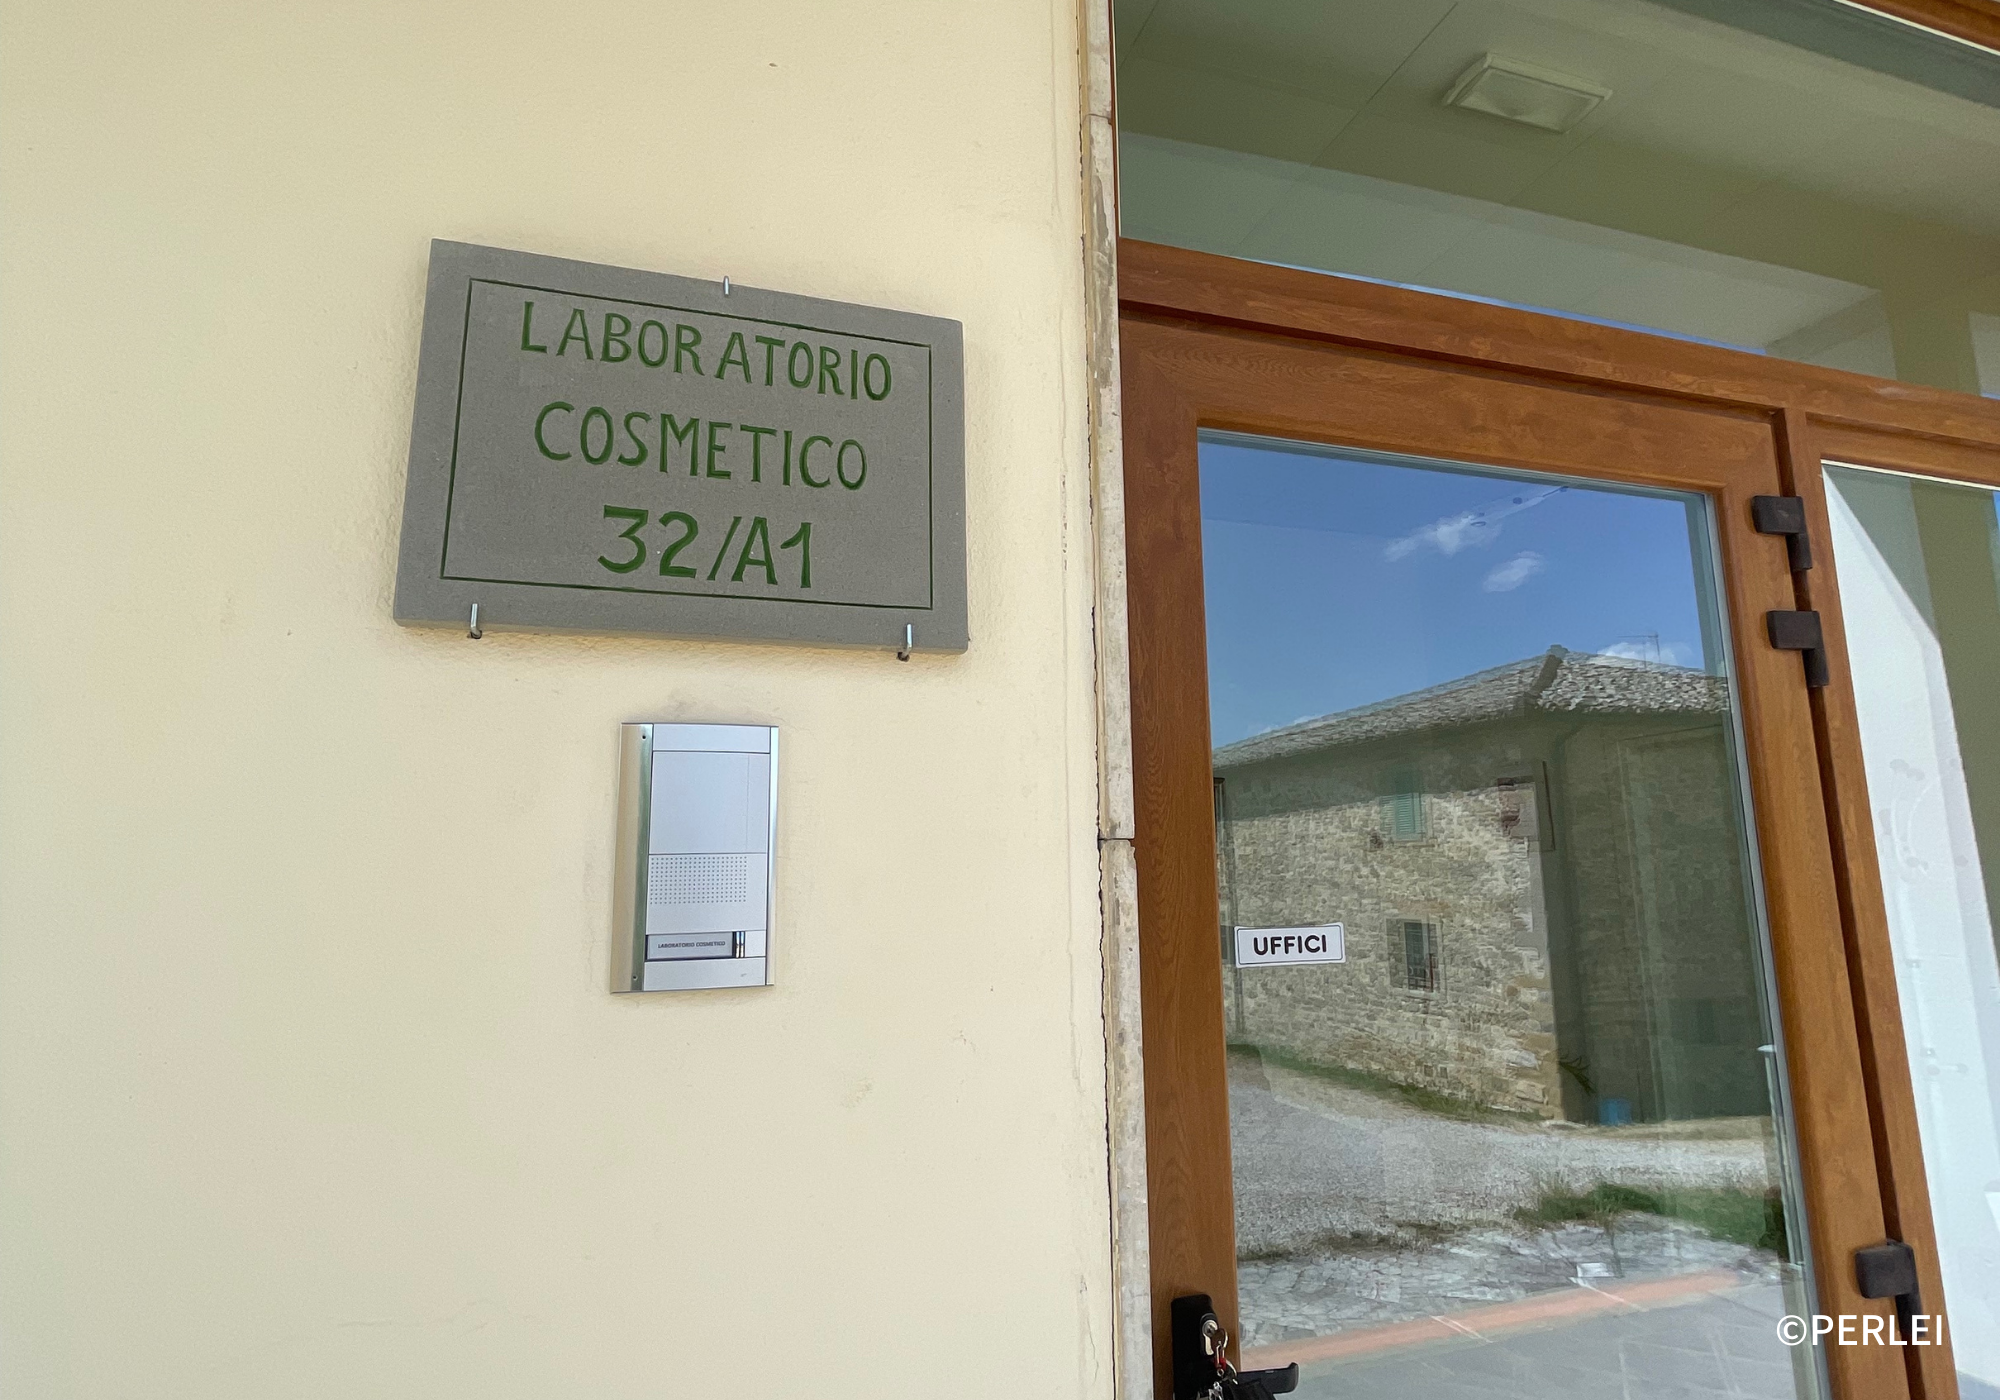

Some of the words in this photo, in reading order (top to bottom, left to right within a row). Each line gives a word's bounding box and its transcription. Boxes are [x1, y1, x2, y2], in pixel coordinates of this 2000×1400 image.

[520, 301, 892, 401] LABORATORIO
[534, 401, 867, 490] COSMETICO
[597, 504, 811, 588] 32/A1
[696, 940, 726, 948] COSMETICO
[1253, 934, 1327, 955] UFFICI
